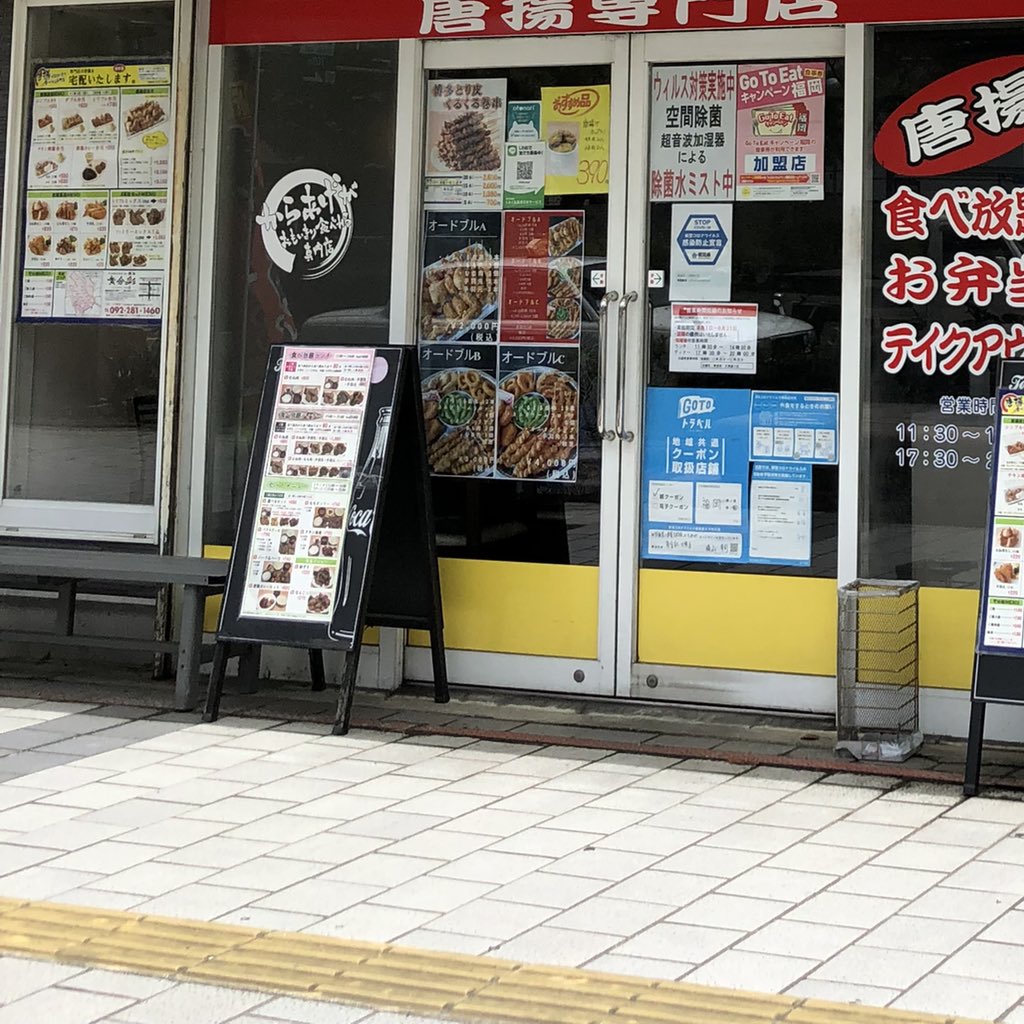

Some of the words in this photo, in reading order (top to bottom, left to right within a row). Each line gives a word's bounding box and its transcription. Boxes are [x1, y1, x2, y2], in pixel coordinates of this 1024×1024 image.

[653, 70, 735, 102] ウィルス対策実施中
[740, 74, 759, 90] Go
[759, 70, 777, 86] To
[779, 65, 804, 84] Eat
[741, 85, 790, 103] キャンペーン
[791, 78, 823, 98] 福岡
[666, 104, 722, 128] 空間除菌
[660, 132, 725, 148] 超音波加湿器
[678, 150, 707, 164] による
[753, 155, 806, 172] 加盟店
[651, 169, 734, 198] 除菌水ミスト中
[428, 219, 487, 233] オードブルA
[422, 347, 481, 361] オードブルB
[501, 351, 565, 365] オードブルC
[682, 418, 711, 429] トラベル
[672, 448, 719, 459] クーポン
[671, 462, 719, 475] 取扱店舗
